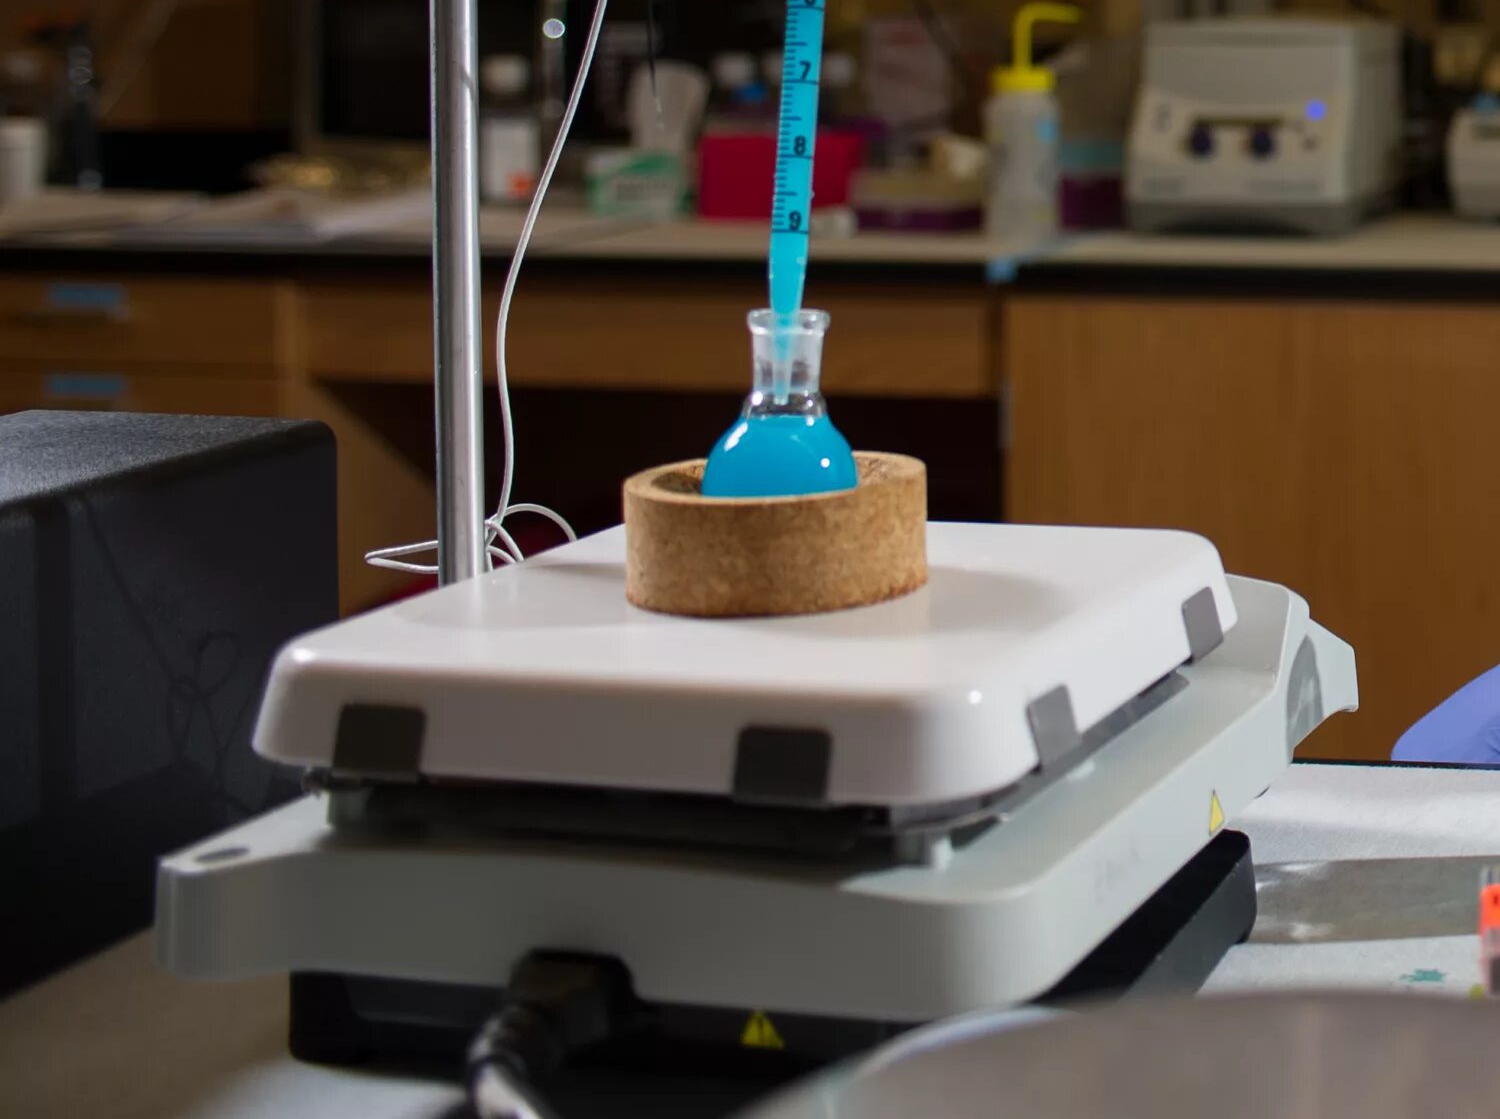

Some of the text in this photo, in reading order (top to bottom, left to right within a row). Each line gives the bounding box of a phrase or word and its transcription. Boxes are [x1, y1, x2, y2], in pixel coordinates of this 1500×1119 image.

[799, 60, 811, 80] 7
[793, 135, 806, 156] 8
[788, 210, 802, 231] 9
